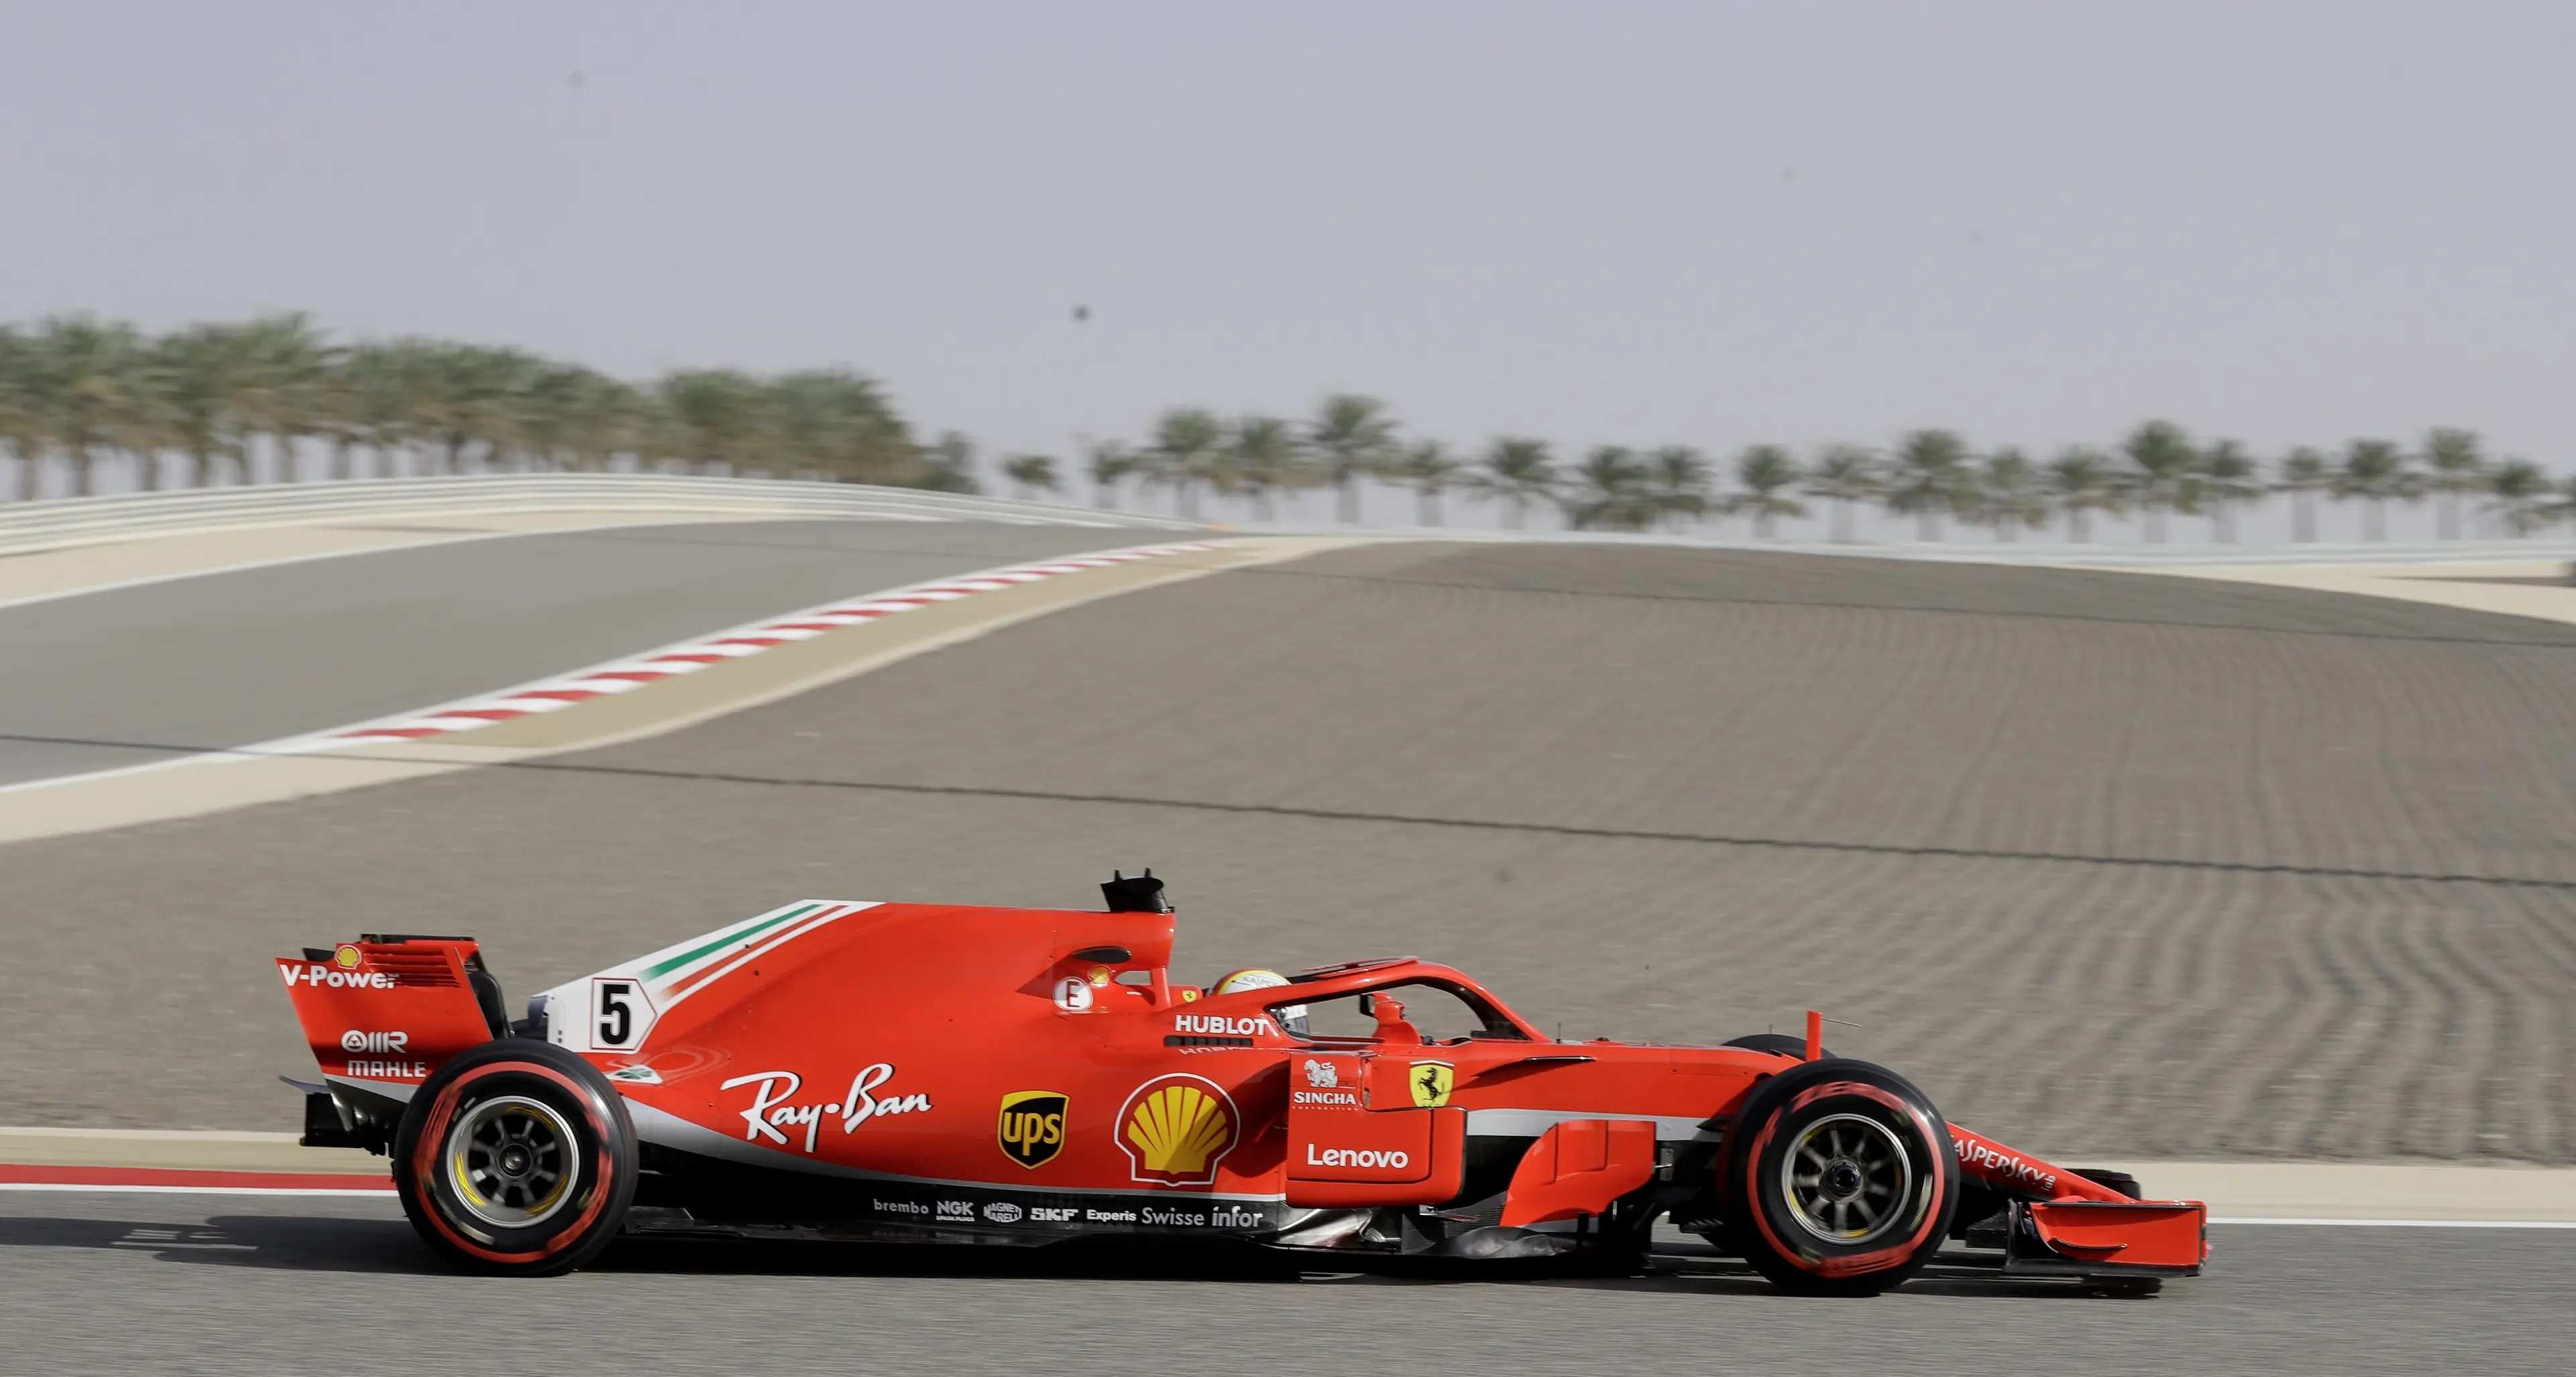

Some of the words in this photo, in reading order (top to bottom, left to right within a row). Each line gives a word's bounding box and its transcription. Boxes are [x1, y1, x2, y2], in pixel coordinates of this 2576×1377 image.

[280, 965, 396, 989] V-Power
[1067, 981, 1079, 1007] E
[600, 983, 630, 1045] 5
[1175, 1015, 1267, 1036] HUBLOT
[347, 1060, 427, 1077] MAHLE
[1293, 1091, 1356, 1105] SINGHA
[1003, 1112, 1061, 1156] ups
[1307, 1144, 1409, 1168] Lenovo
[1950, 1135, 2047, 1185] ASPERSKY
[873, 1198, 929, 1215] brembo
[936, 1201, 974, 1215] NGK
[1030, 1208, 1079, 1221] SKF
[1087, 1209, 1136, 1222] Experis
[1142, 1207, 1204, 1225] Swisse
[1212, 1205, 1263, 1227] infor
